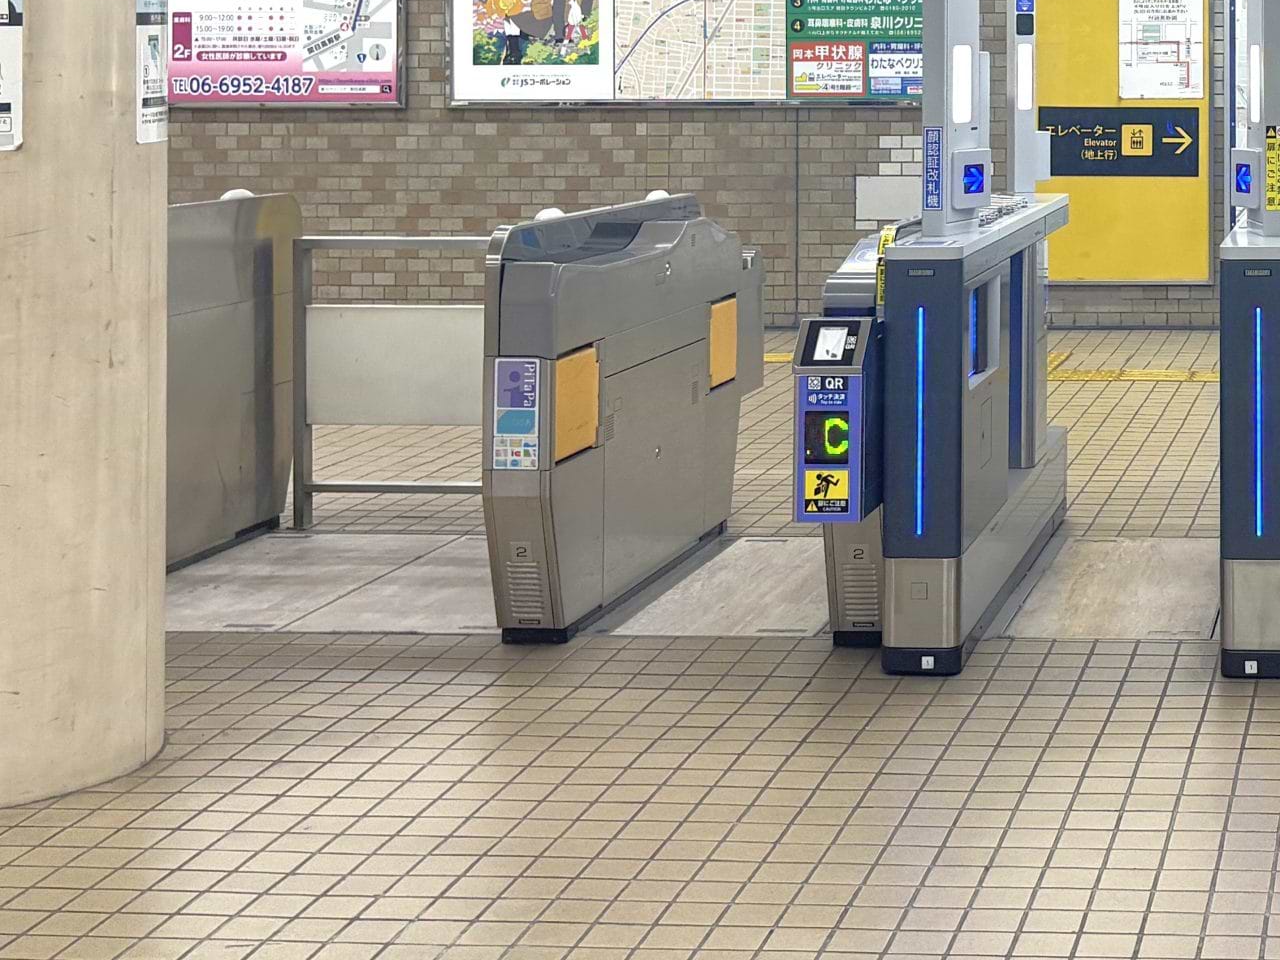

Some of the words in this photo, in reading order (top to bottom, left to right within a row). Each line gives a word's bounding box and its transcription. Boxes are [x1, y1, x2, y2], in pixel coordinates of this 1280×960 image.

[174, 44, 191, 59] 2F
[816, 62, 862, 71] クリニック
[174, 79, 189, 94] TEL
[189, 77, 314, 94] 06-6952-4187
[1045, 125, 1116, 136] エレベーター
[1084, 138, 1117, 147] Elevator
[1081, 150, 1118, 161] (地上行)
[927, 130, 939, 208] 顔認証改札機
[1266, 142, 1276, 206] 扉にご注意
[524, 363, 536, 407] PiTaPa
[825, 377, 844, 389] QR
[516, 546, 527, 557] 2
[853, 548, 864, 559] 2
